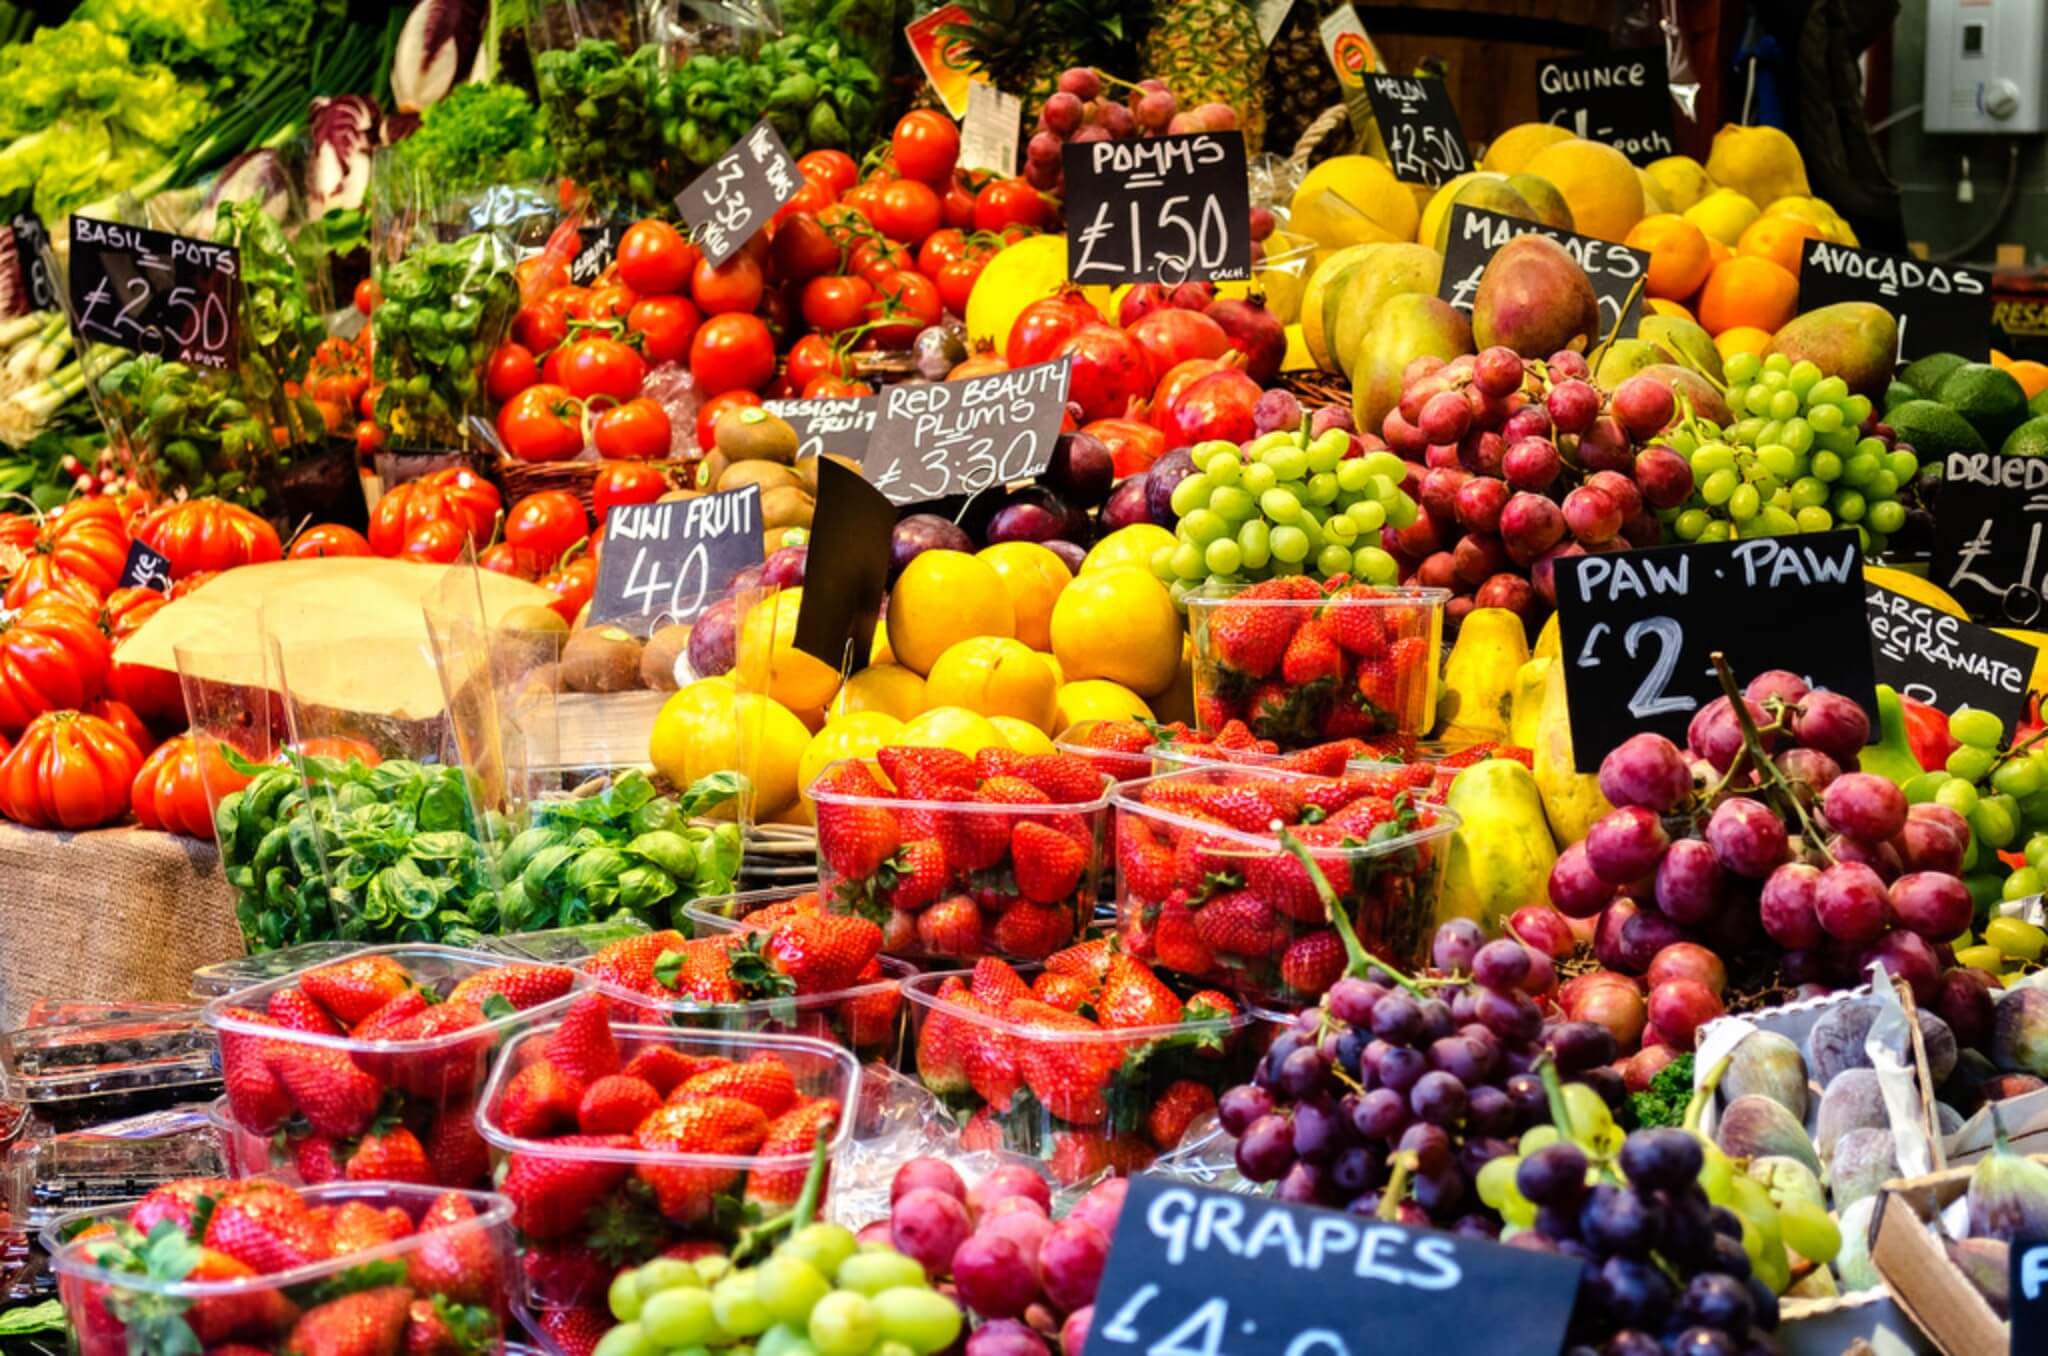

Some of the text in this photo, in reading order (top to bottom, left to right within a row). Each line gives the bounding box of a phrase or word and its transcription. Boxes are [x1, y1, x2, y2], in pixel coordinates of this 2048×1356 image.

[1093, 135, 1226, 176] POMMS
[1390, 123, 1465, 176] £2.50
[75, 218, 150, 255] BASIL
[1073, 193, 1229, 280] £1.50
[1809, 241, 1986, 295] AVOCADOS
[79, 275, 229, 351] £2.50
[914, 398, 1036, 449] PLUMS
[609, 485, 759, 541] KIWI FRUIT
[1577, 538, 1855, 602] PAW PAW
[1146, 1186, 1462, 1290] GRAPES
